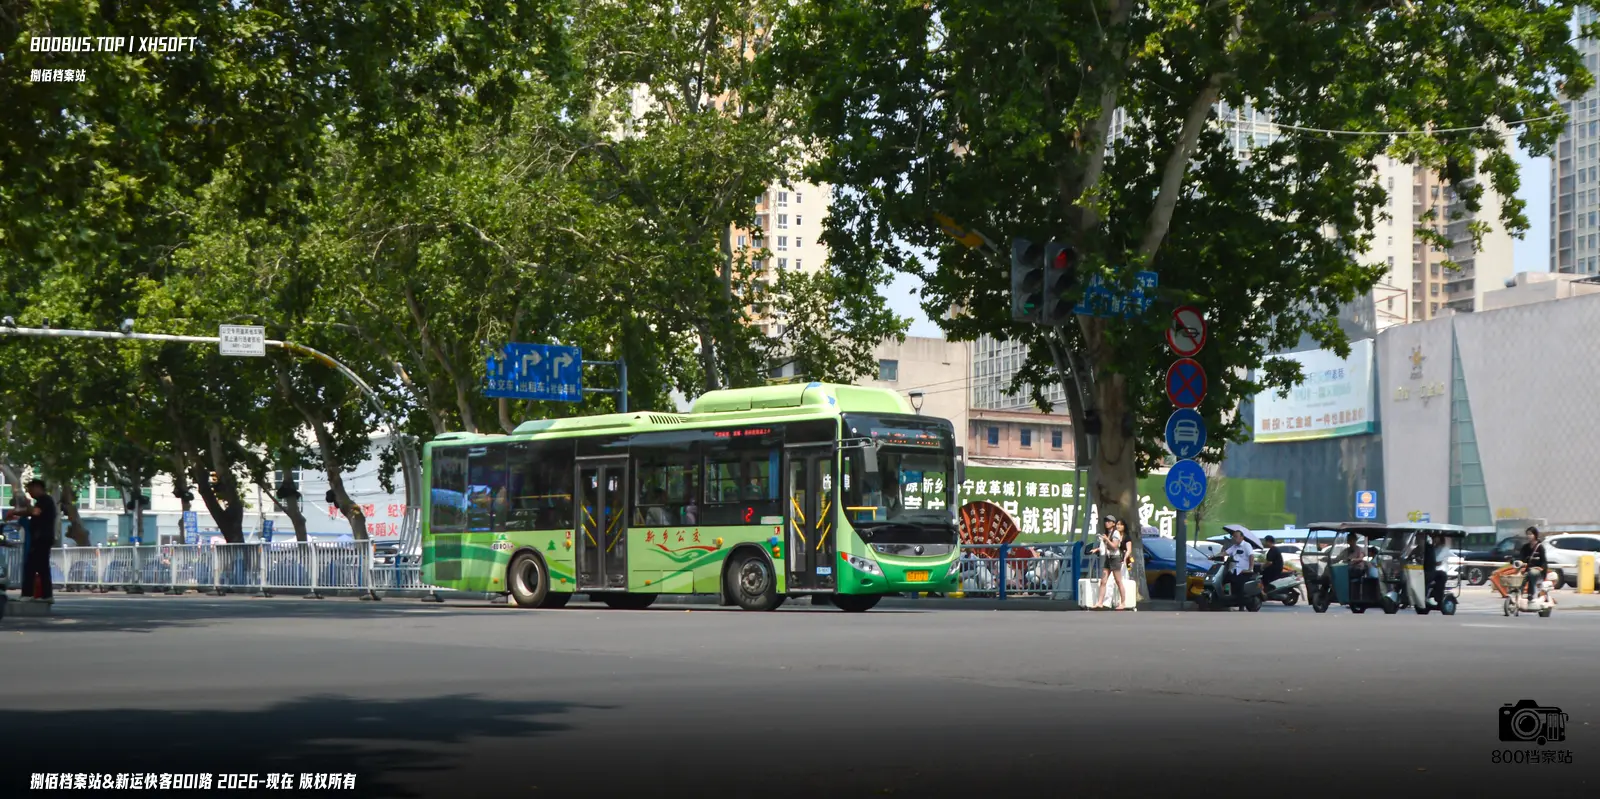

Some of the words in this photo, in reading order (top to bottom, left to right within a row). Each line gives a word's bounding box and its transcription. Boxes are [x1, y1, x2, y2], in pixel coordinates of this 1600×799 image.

[520, 381, 545, 392] 出租车
[645, 528, 700, 544] 新乡公交
